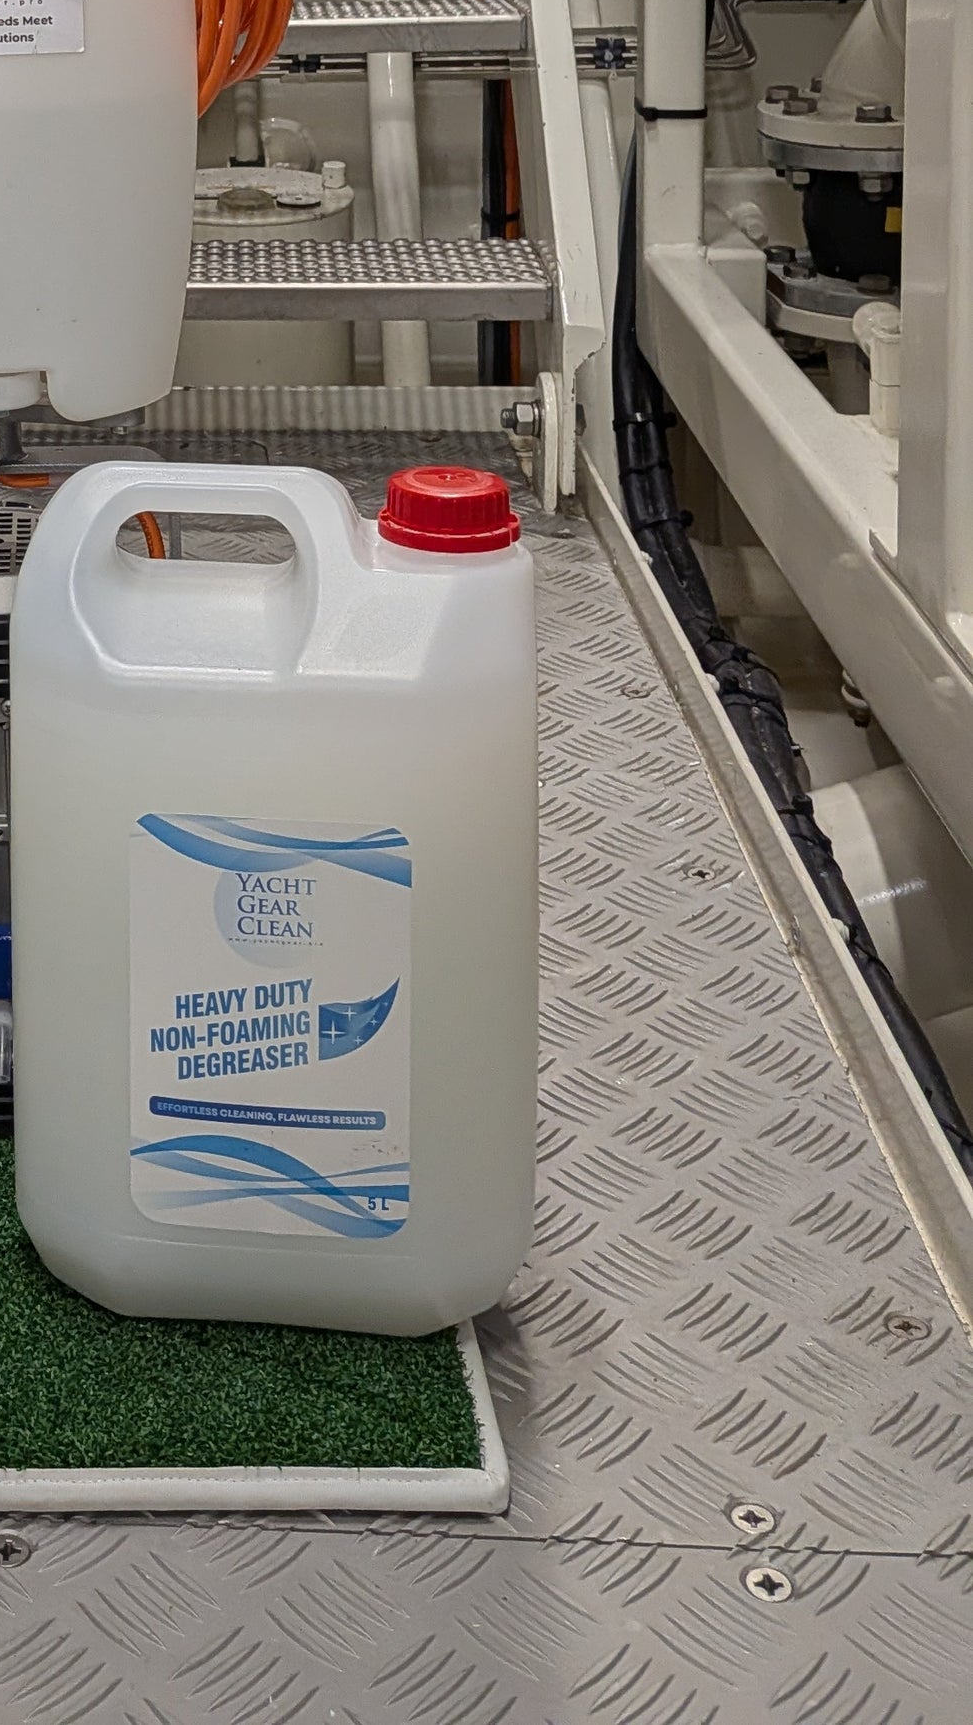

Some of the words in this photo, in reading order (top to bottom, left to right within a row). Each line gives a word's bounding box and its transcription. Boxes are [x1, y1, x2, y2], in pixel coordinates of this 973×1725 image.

[22, 15, 53, 26] Meet
[235, 872, 317, 895] YACHT
[237, 895, 301, 916] GEAR
[237, 916, 314, 938] CLEAN
[175, 987, 248, 1020] HEAVY
[254, 978, 313, 1010] DUTY
[150, 1010, 311, 1053] NON-FOAMING
[178, 1041, 309, 1080] DEGREASER
[157, 1101, 218, 1117] EFFORTLESS
[220, 1108, 277, 1123] CLEANING,
[277, 1113, 331, 1124] FLAWLESS
[332, 1116, 377, 1125] RESULTS
[367, 1198, 377, 1211] 5
[381, 1198, 390, 1211] L
